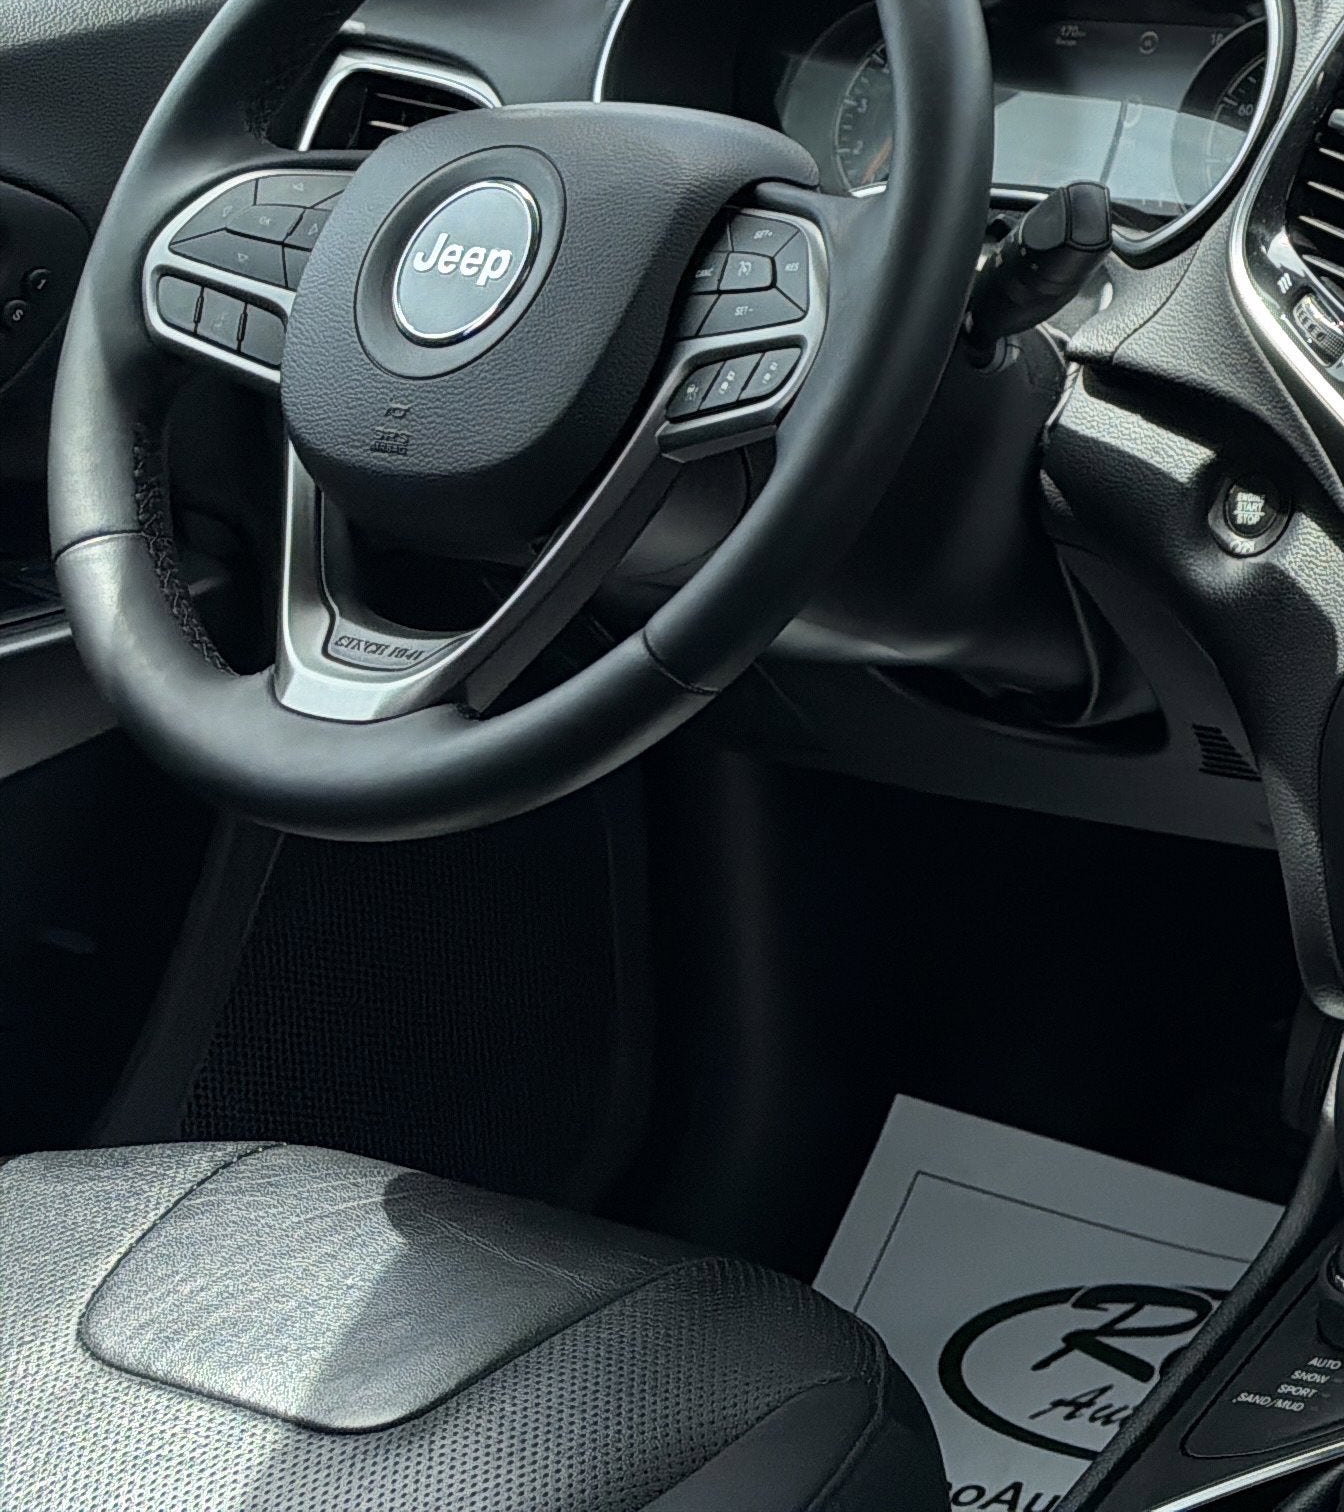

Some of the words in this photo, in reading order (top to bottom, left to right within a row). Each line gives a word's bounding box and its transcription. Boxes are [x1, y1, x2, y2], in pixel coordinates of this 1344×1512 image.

[413, 232, 512, 286] Jeep
[1237, 501, 1264, 512] START
[1237, 513, 1261, 525] STOP
[1307, 1357, 1342, 1370] AUTO
[1290, 1369, 1330, 1383] SNOW
[1277, 1383, 1318, 1398] SPORT
[1028, 1384, 1133, 1428] Au
